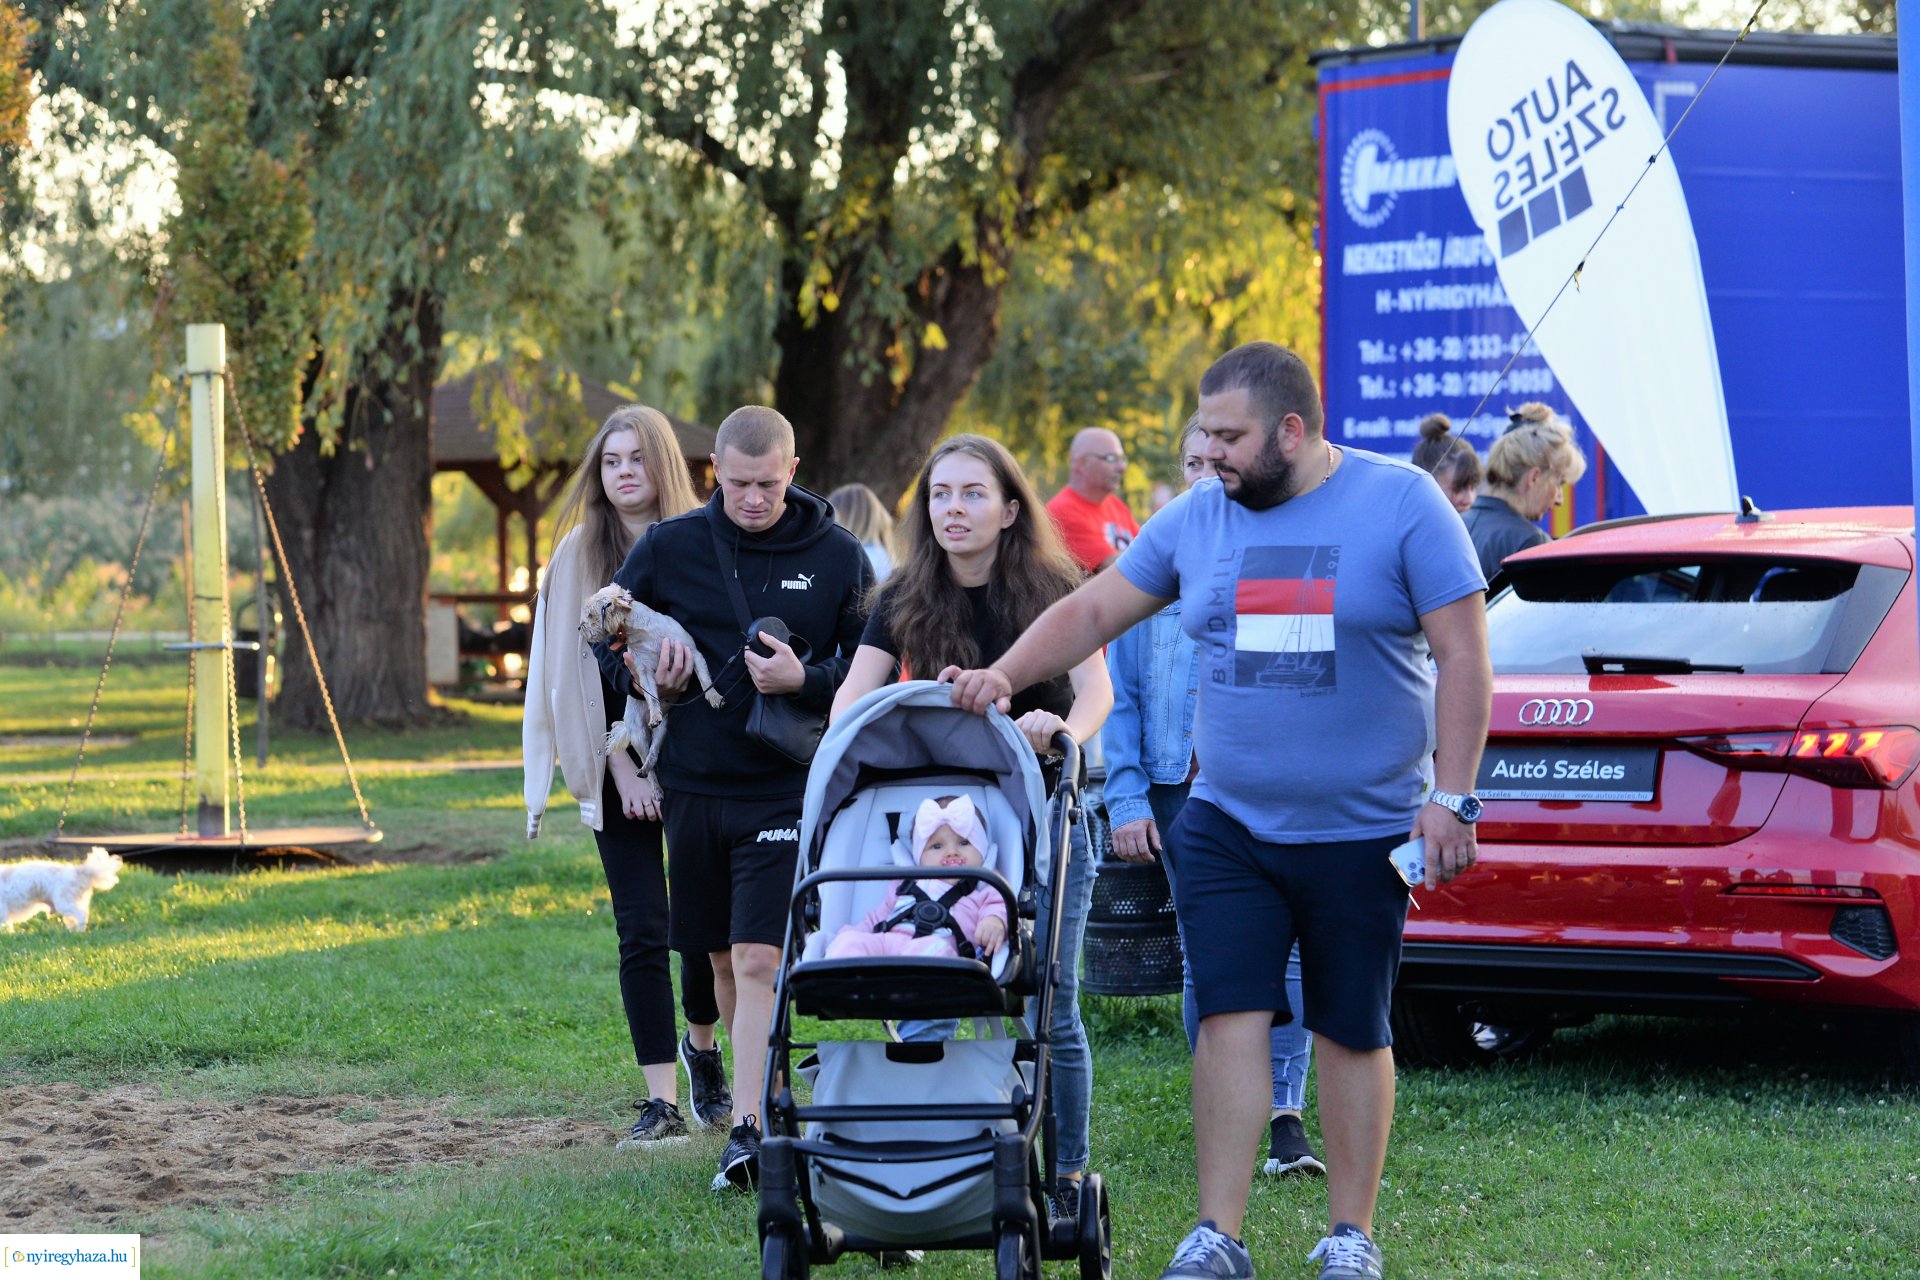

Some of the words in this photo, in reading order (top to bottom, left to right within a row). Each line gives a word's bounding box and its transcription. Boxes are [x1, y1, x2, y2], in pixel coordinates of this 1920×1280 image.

[1323, 546, 1342, 593] 1990
[781, 579, 808, 591] PUMA
[1208, 549, 1237, 685] BUDMIL
[1491, 759, 1548, 779] Autó
[1553, 759, 1625, 780] Széles
[757, 828, 798, 842] PUMA
